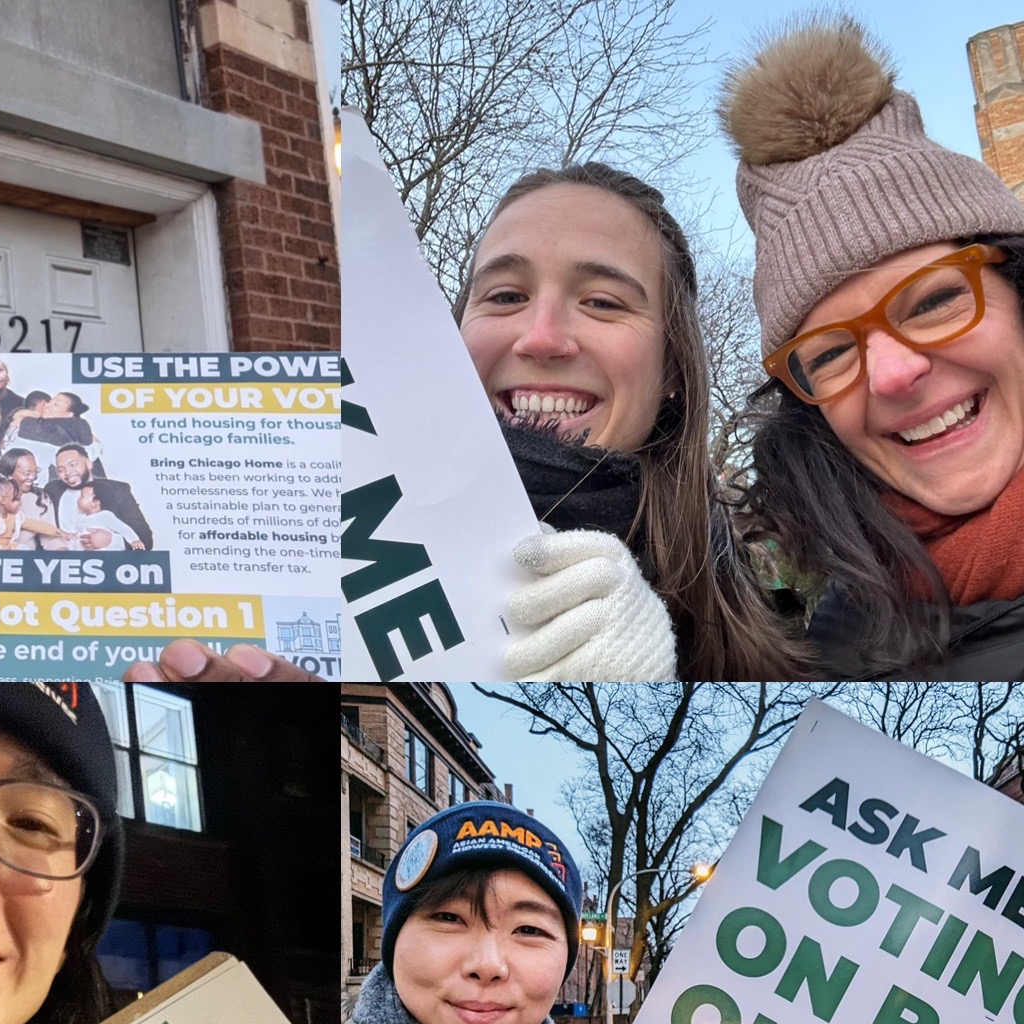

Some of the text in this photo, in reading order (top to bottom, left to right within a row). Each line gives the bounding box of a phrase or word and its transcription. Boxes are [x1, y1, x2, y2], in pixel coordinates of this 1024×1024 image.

[80, 357, 144, 378] USE
[153, 357, 220, 378] THE
[109, 388, 155, 409] OF
[165, 388, 263, 409] YOUR
[131, 418, 282, 431] to fund housing for
[139, 433, 295, 446] of Chicago families.
[150, 458, 283, 470] Bring Chicago Home
[34, 559, 105, 584] YES
[116, 563, 163, 585] on
[341, 474, 465, 682] ME
[51, 597, 228, 632] Question
[238, 602, 255, 628] 1
[14, 641, 63, 660] end
[72, 641, 99, 661] of
[457, 821, 542, 848] AAMP
[798, 777, 948, 874] ASK
[716, 906, 860, 1023] ON
